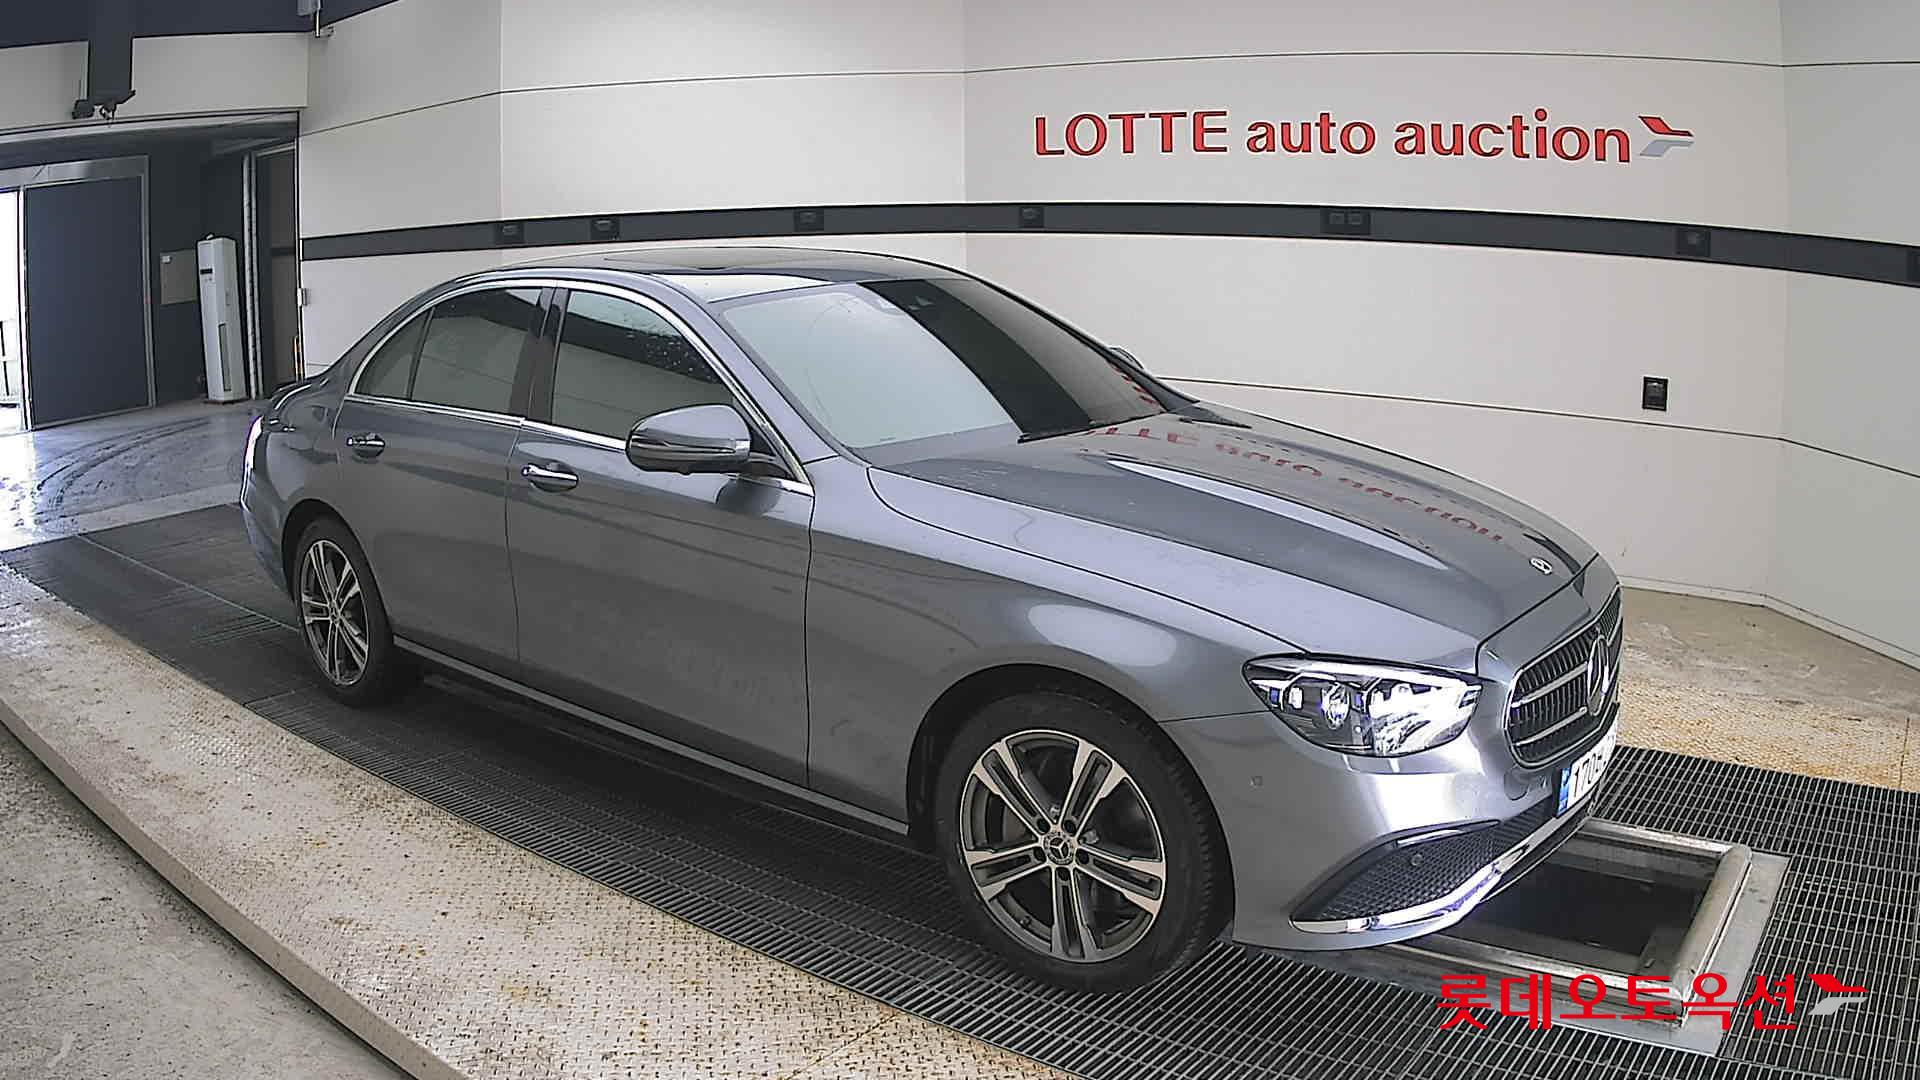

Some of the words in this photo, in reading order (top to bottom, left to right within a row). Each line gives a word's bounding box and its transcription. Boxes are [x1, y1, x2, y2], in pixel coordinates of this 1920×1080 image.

[1035, 111, 1229, 156] LOTTE
[1246, 112, 1376, 155] auto
[1393, 108, 1631, 163] auction
